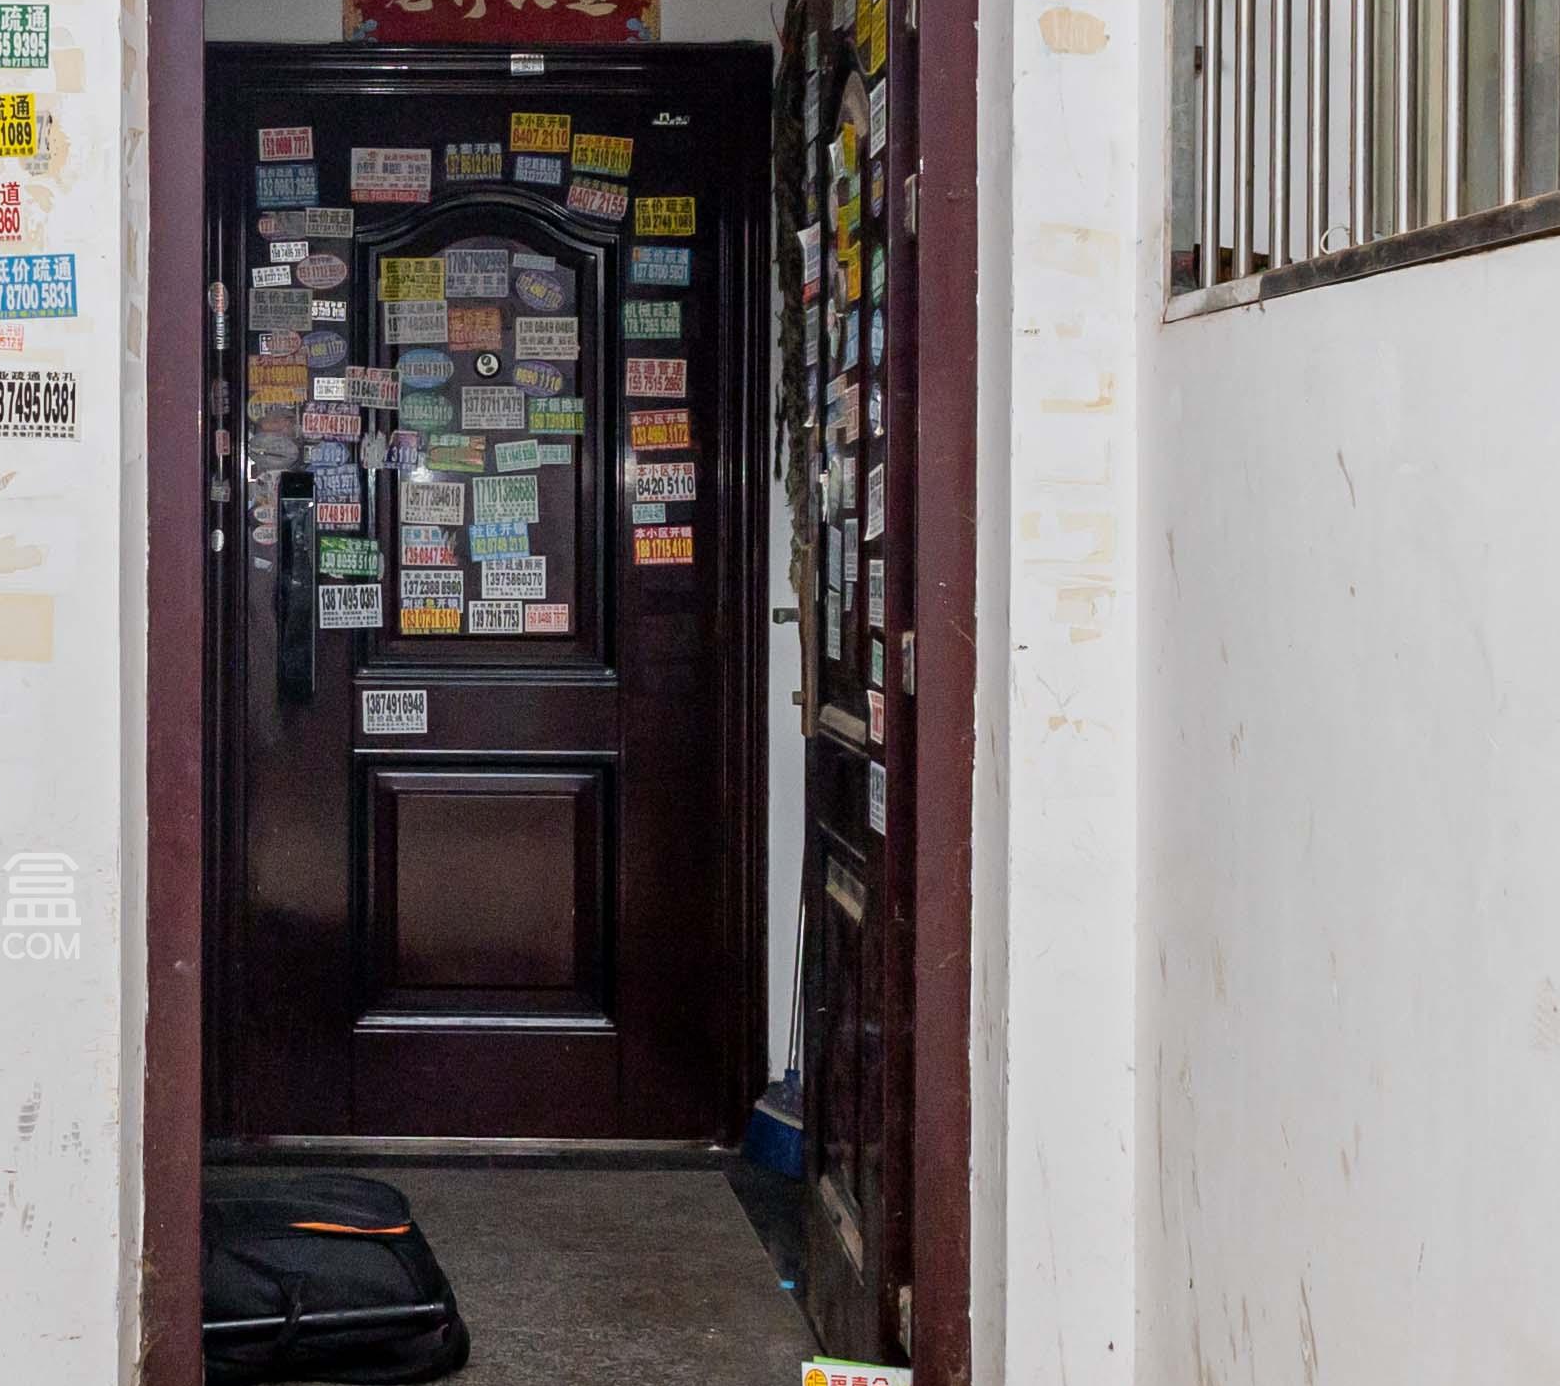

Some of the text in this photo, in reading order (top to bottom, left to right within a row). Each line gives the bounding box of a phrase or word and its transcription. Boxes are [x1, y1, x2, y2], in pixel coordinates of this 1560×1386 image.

[13, 32, 46, 58] 9395
[0, 121, 32, 147] 1089
[5, 282, 40, 311] 8700
[40, 281, 73, 310] 5831
[45, 370, 77, 383] 钻孔
[7, 381, 42, 424] 7495
[43, 382, 77, 425] 0381
[637, 475, 695, 496] 8420 5110
